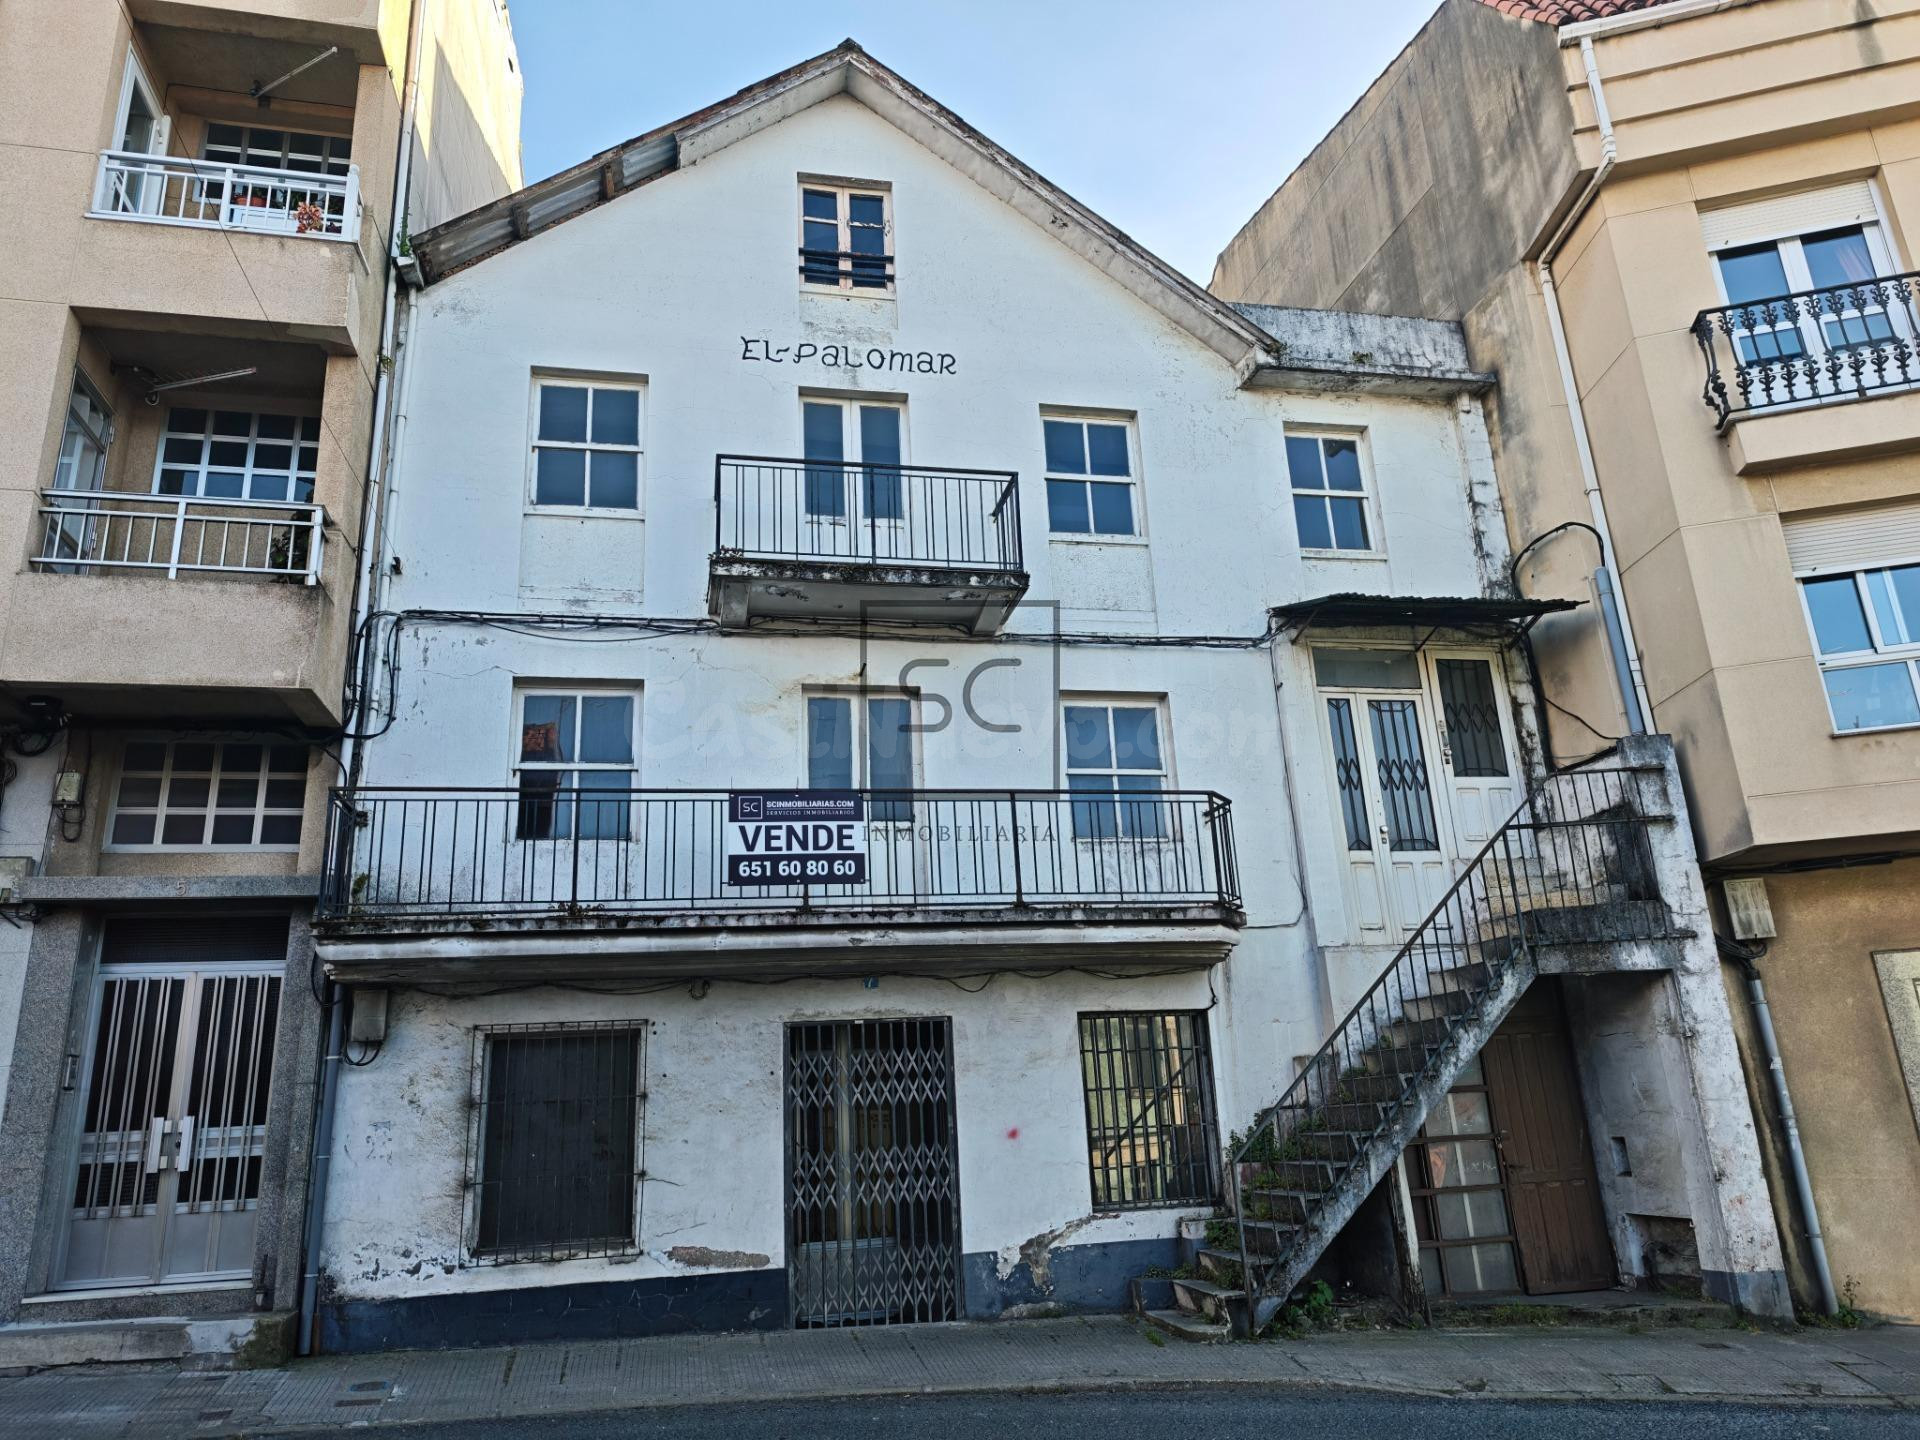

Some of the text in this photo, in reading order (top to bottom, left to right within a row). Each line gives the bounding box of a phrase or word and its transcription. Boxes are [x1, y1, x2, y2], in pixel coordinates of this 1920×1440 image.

[743, 802, 758, 812] SC
[766, 800, 854, 808] SCINMOBILIARIAS.COM
[738, 824, 855, 852] VENDE
[738, 859, 856, 877] 651 60 80 60
